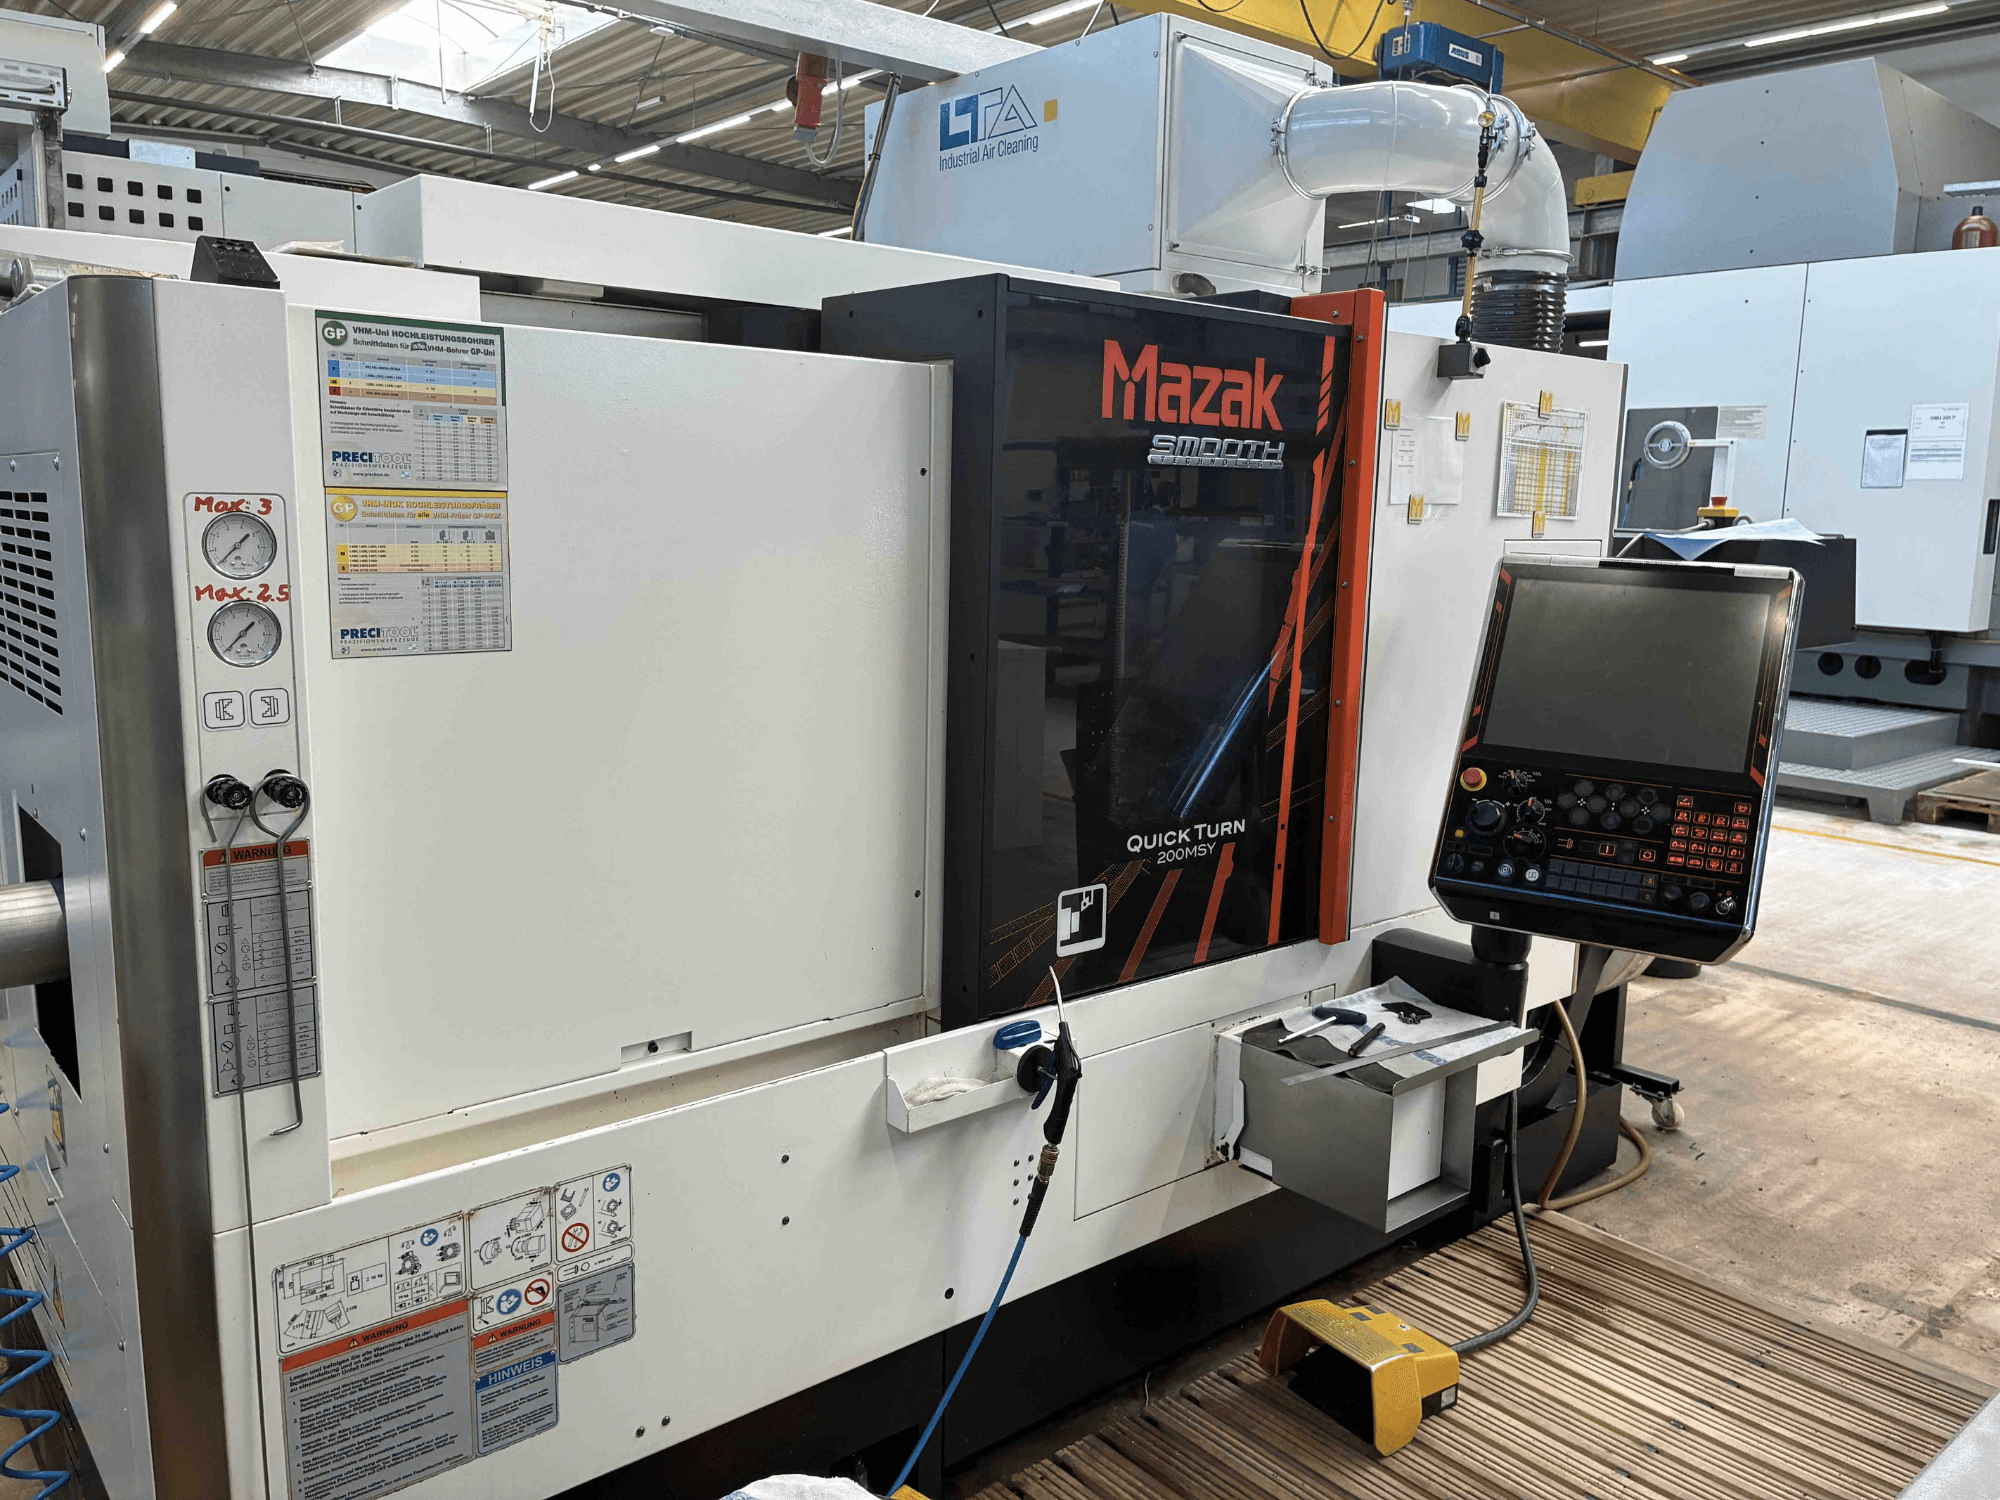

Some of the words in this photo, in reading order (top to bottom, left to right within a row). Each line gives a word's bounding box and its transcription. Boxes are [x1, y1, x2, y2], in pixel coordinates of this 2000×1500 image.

[940, 146, 980, 171] Industrial
[982, 143, 996, 161] Air
[998, 135, 1039, 157] Cleaning
[323, 327, 347, 340] GP
[353, 326, 389, 337] VHM-Uni
[392, 331, 495, 346] HOCHLEISTUNGSBOHRER
[353, 339, 399, 350] Schnittdaten
[400, 342, 410, 350] für
[427, 345, 469, 355] VHM-Bohrer
[471, 348, 496, 357] GP-Uni
[1102, 339, 1283, 431] Mazak
[1150, 434, 1285, 461] SMOOTH
[1160, 457, 1275, 468] TECHNOLOGY
[257, 497, 272, 515] 3
[333, 502, 354, 514] GP
[257, 583, 292, 602] 2.5
[1127, 828, 1191, 853] QUICK
[1194, 819, 1246, 840] TURN
[234, 845, 291, 861] WARNUG
[1157, 842, 1217, 864] 200MSY
[362, 1322, 409, 1342] WARNUNG
[500, 1318, 541, 1338] WARNUNG
[488, 1356, 543, 1385] HINWEIS
